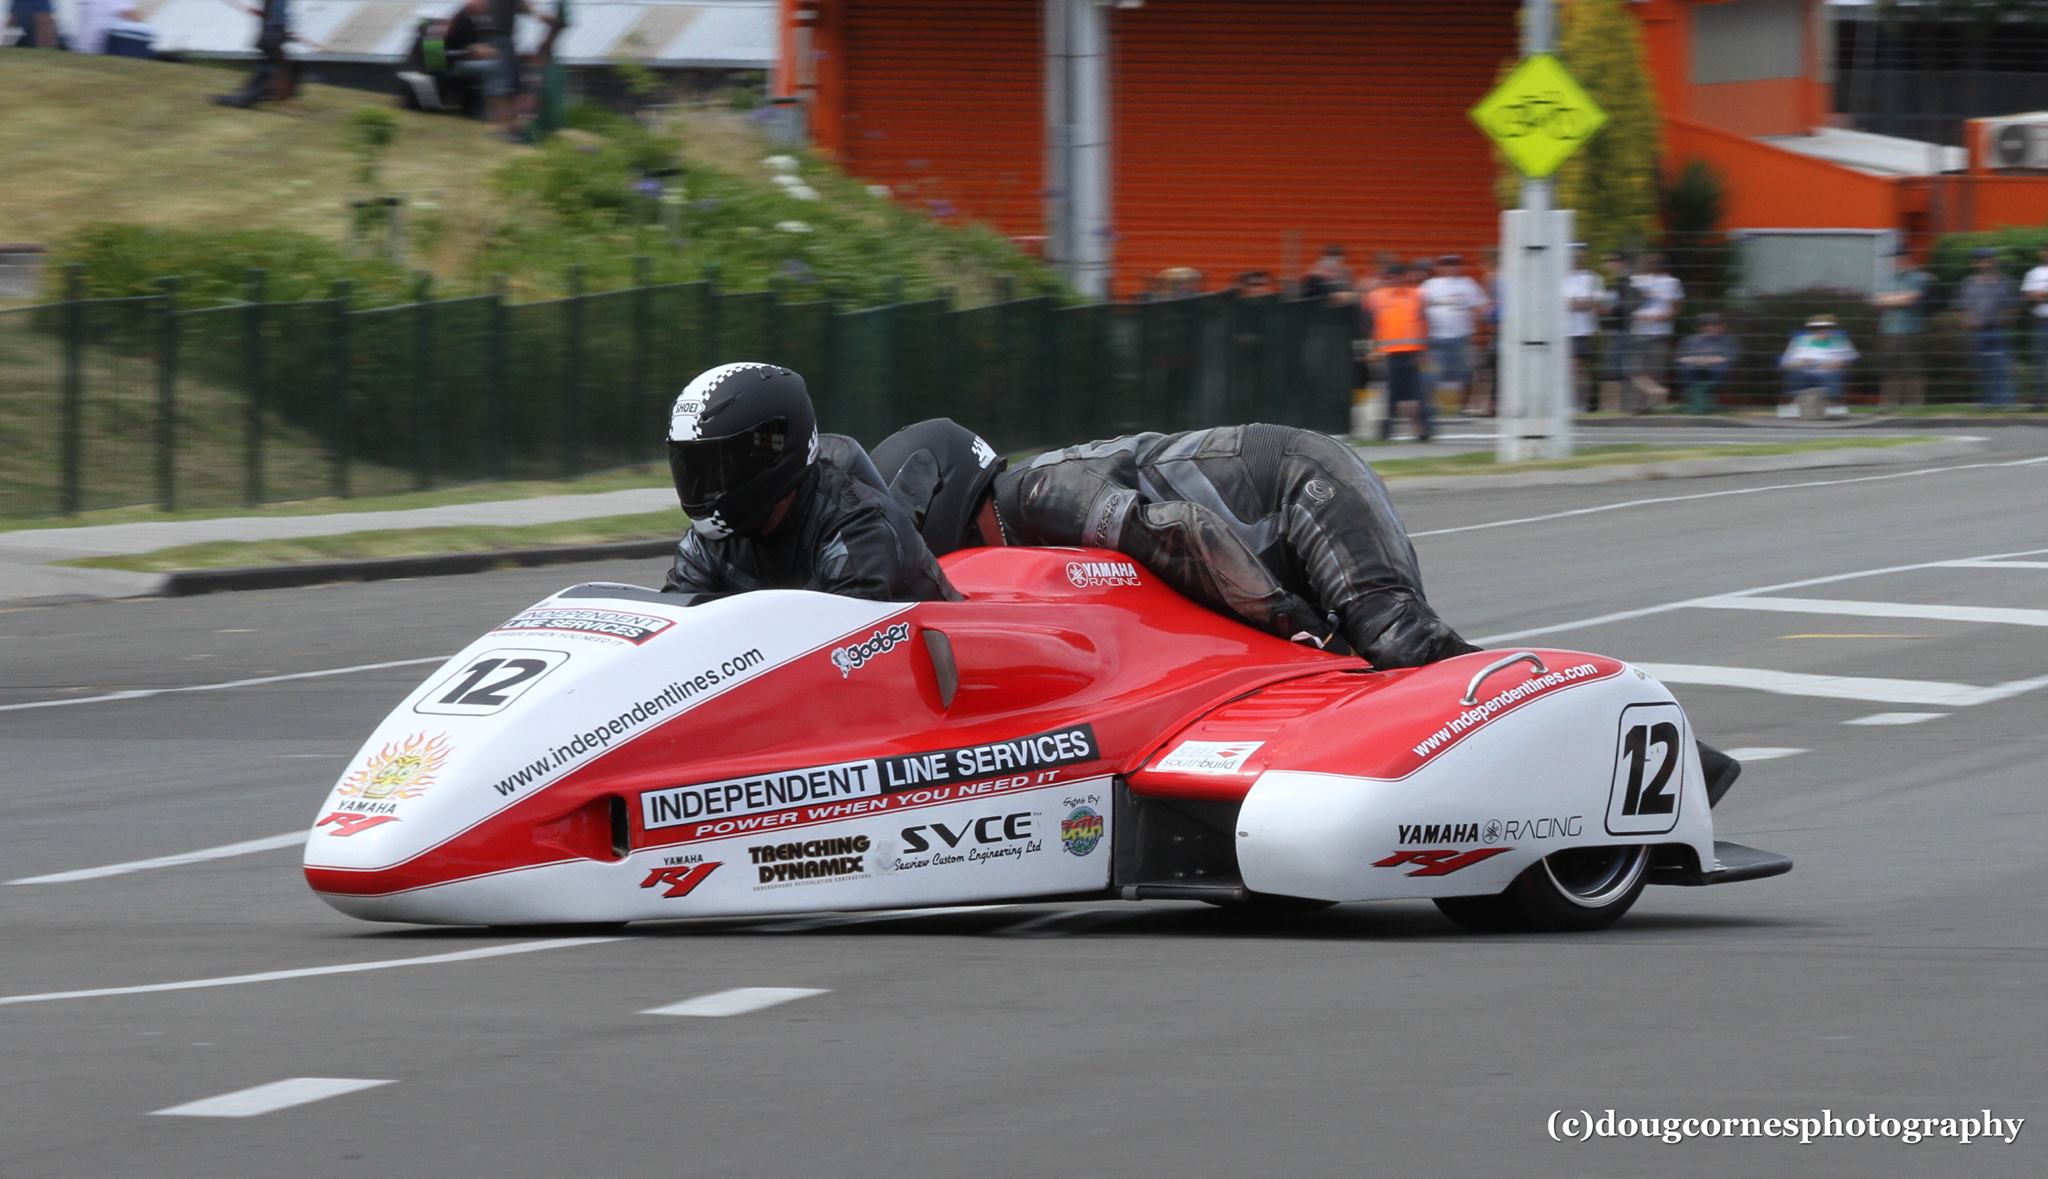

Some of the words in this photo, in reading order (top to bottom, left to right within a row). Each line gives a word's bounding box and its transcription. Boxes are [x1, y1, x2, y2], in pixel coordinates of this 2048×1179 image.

[675, 402, 699, 414] SHOEI
[1083, 563, 1137, 577] YAMAHA
[1089, 577, 1142, 587] RACING
[502, 619, 544, 630] LINE
[545, 619, 644, 638] SERVICES
[520, 610, 660, 628] INDEPENDENT
[847, 623, 908, 667] goober
[438, 658, 548, 706] 12
[494, 648, 765, 796] www.independentlines.com
[650, 764, 869, 823] INDEPENDENT
[886, 756, 950, 786] LINE
[957, 730, 1090, 776] SERVICES
[1162, 758, 1237, 770] southbuild
[1622, 721, 1681, 816] 12
[337, 800, 397, 814] YAMAHA
[695, 811, 797, 837] POWER
[807, 800, 888, 819] WHEN
[898, 791, 949, 806] YOU
[958, 778, 1029, 795] NEED
[1036, 770, 1061, 783] IT
[315, 812, 403, 837] R1
[901, 811, 1031, 854] SVCE
[1398, 823, 1478, 845] YAMAHA
[1504, 815, 1583, 841] RACING
[663, 854, 704, 866] YAMAHA
[748, 834, 871, 865] TRENCHING
[895, 857, 930, 871] Seaview
[932, 852, 965, 866] Custom
[968, 844, 1023, 864] Engineering
[1026, 839, 1043, 854] Ltd
[1369, 847, 1516, 877] R1
[639, 861, 726, 899] R1
[758, 855, 864, 884] DYNAMIX
